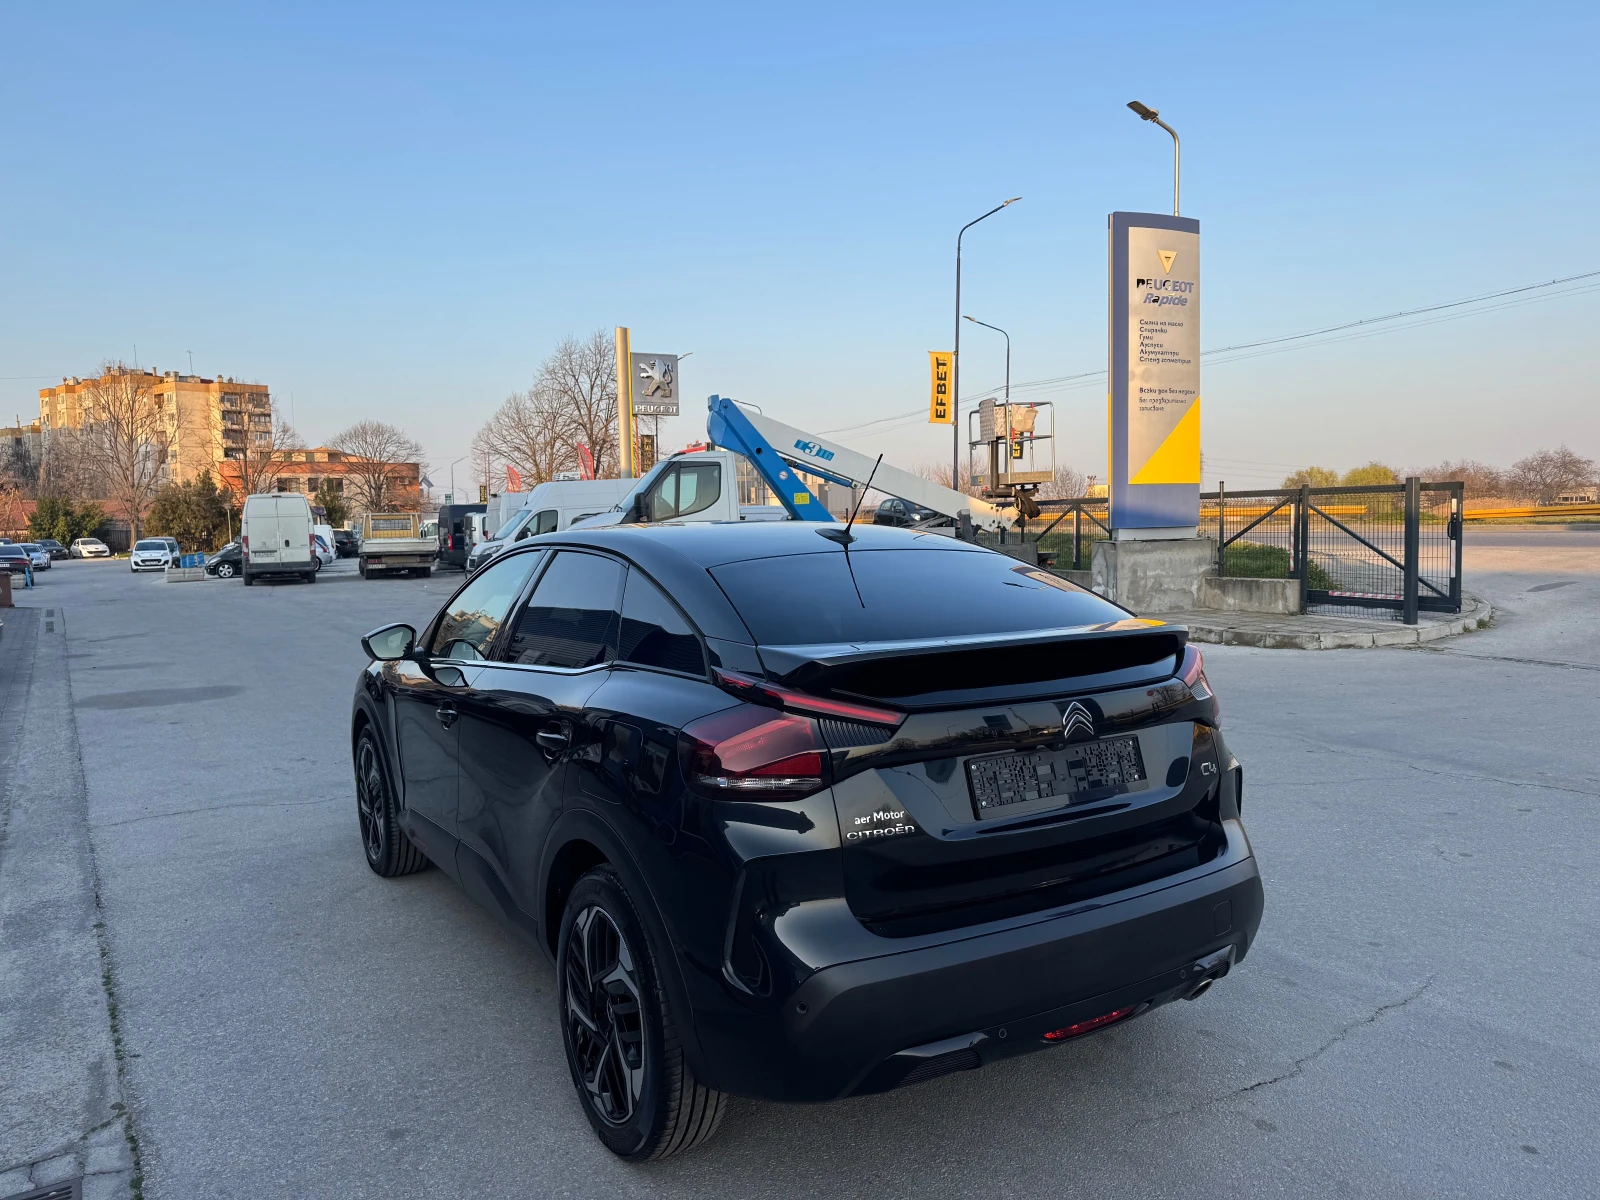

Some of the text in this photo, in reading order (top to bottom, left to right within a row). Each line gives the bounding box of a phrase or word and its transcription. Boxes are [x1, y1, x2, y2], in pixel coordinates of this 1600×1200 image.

[1136, 278, 1195, 293] PEUGEOT
[1143, 292, 1188, 307] Rapide
[1139, 334, 1154, 342] Гуми
[935, 356, 948, 419] EFBET
[635, 404, 678, 414] PEUGEOT
[1200, 761, 1217, 776] C4
[854, 810, 905, 825] aer Motor
[846, 823, 915, 840] CITROËN
